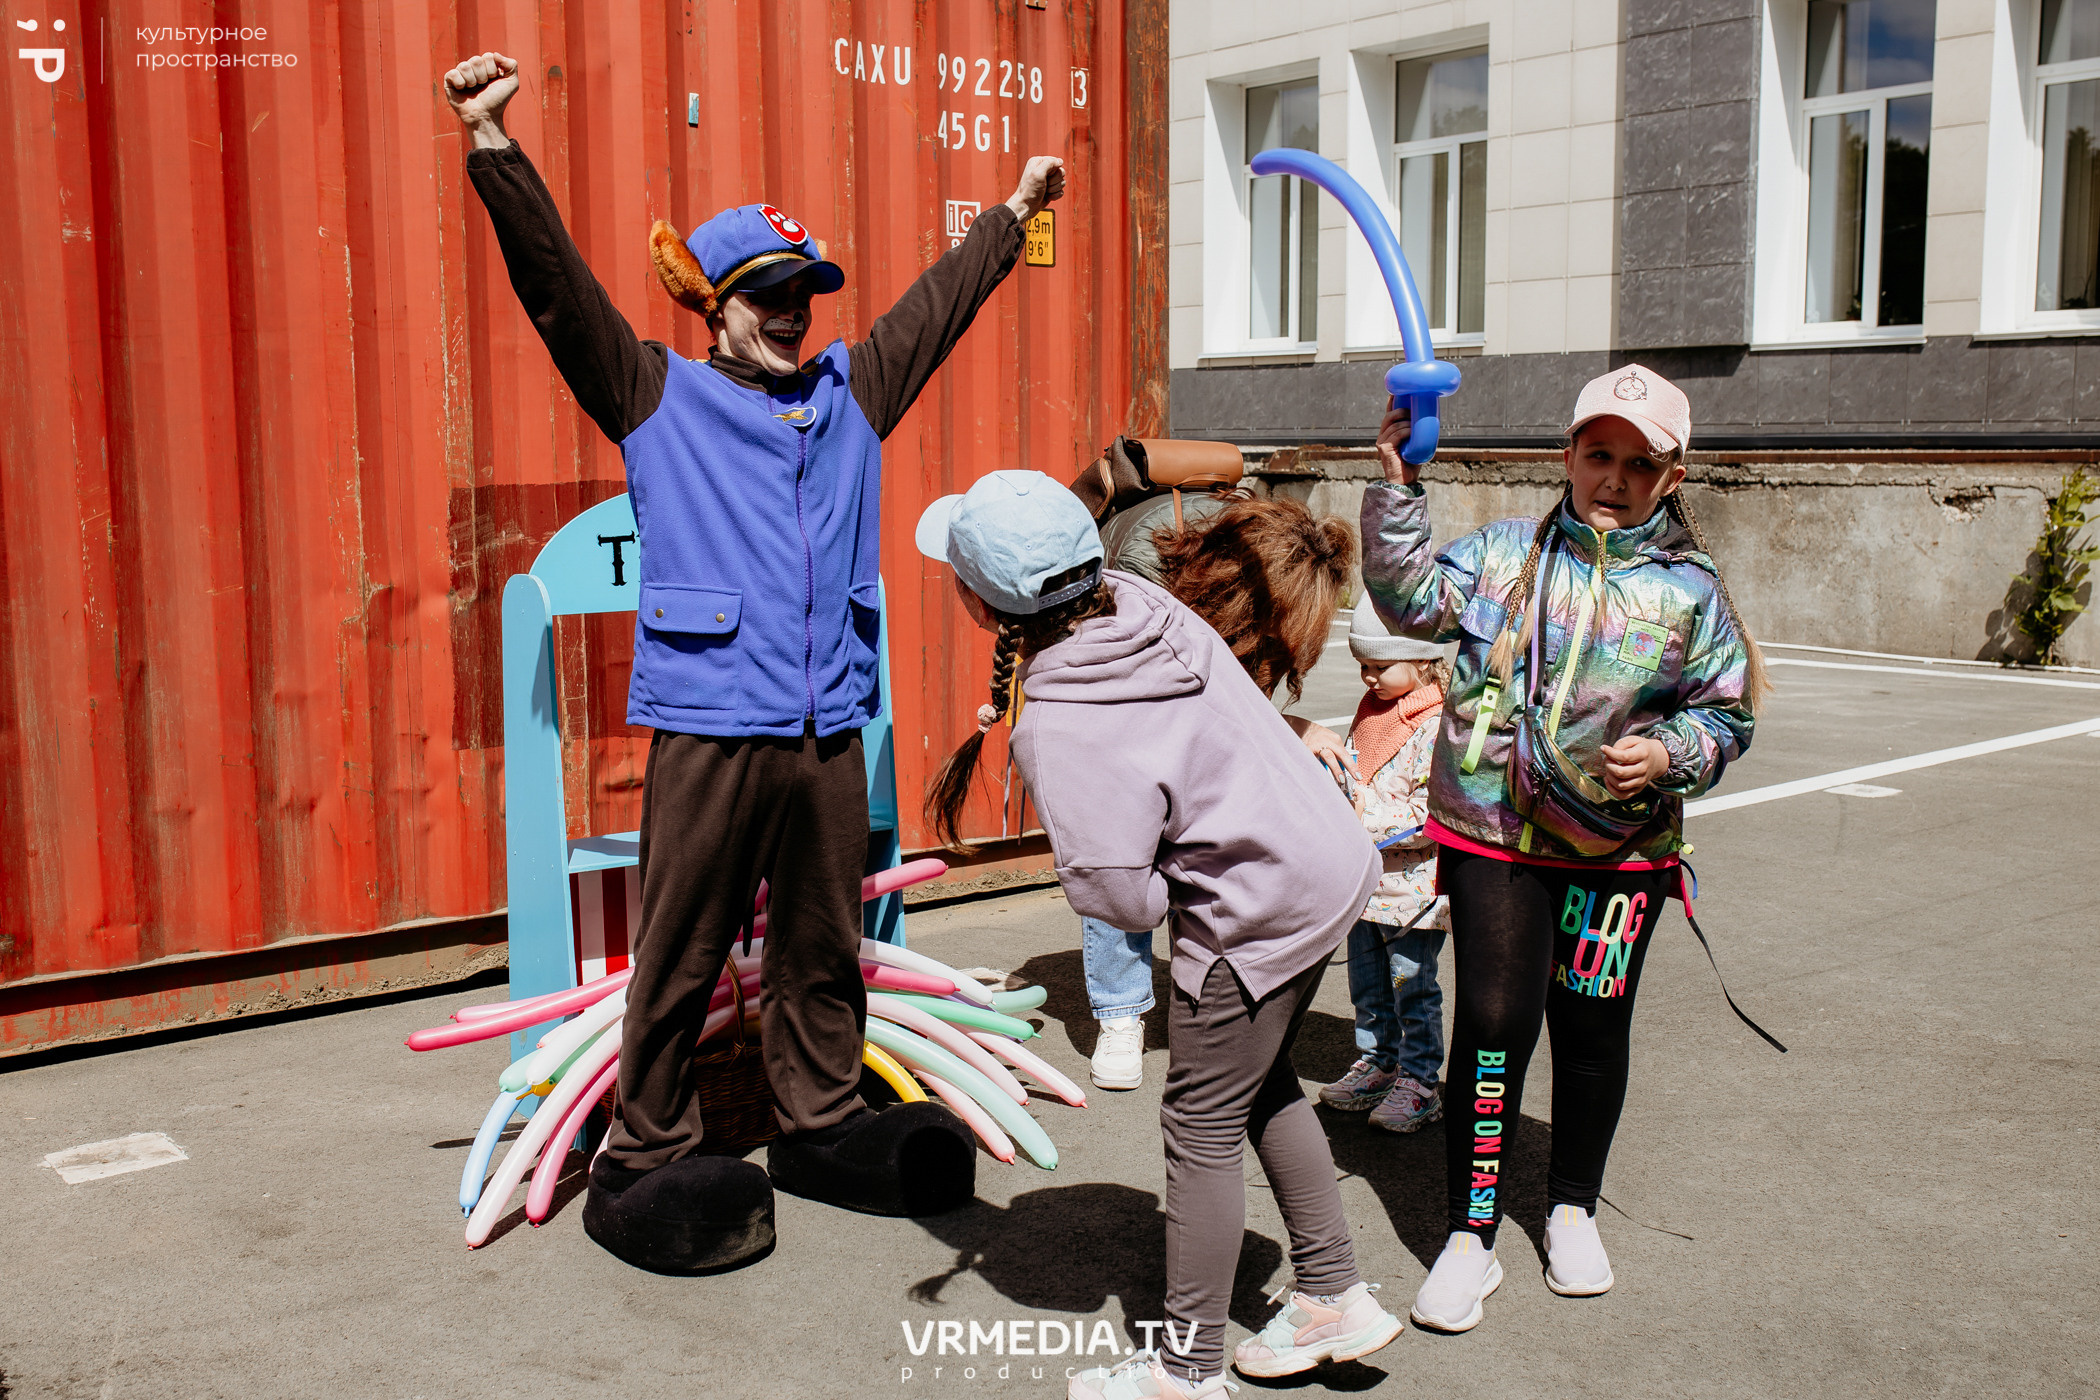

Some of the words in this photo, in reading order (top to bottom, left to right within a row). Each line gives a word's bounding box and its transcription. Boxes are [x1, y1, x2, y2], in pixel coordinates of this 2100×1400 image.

[834, 37, 911, 85] CAXU
[938, 53, 1043, 104] 992258
[1073, 69, 1088, 107] 3
[938, 110, 1010, 153] 45G1
[597, 530, 640, 586] T
[1560, 884, 1648, 945] BLOG
[1550, 959, 1627, 998] FASHION
[1474, 1049, 1506, 1114] BLOG
[1474, 1120, 1503, 1153] ON
